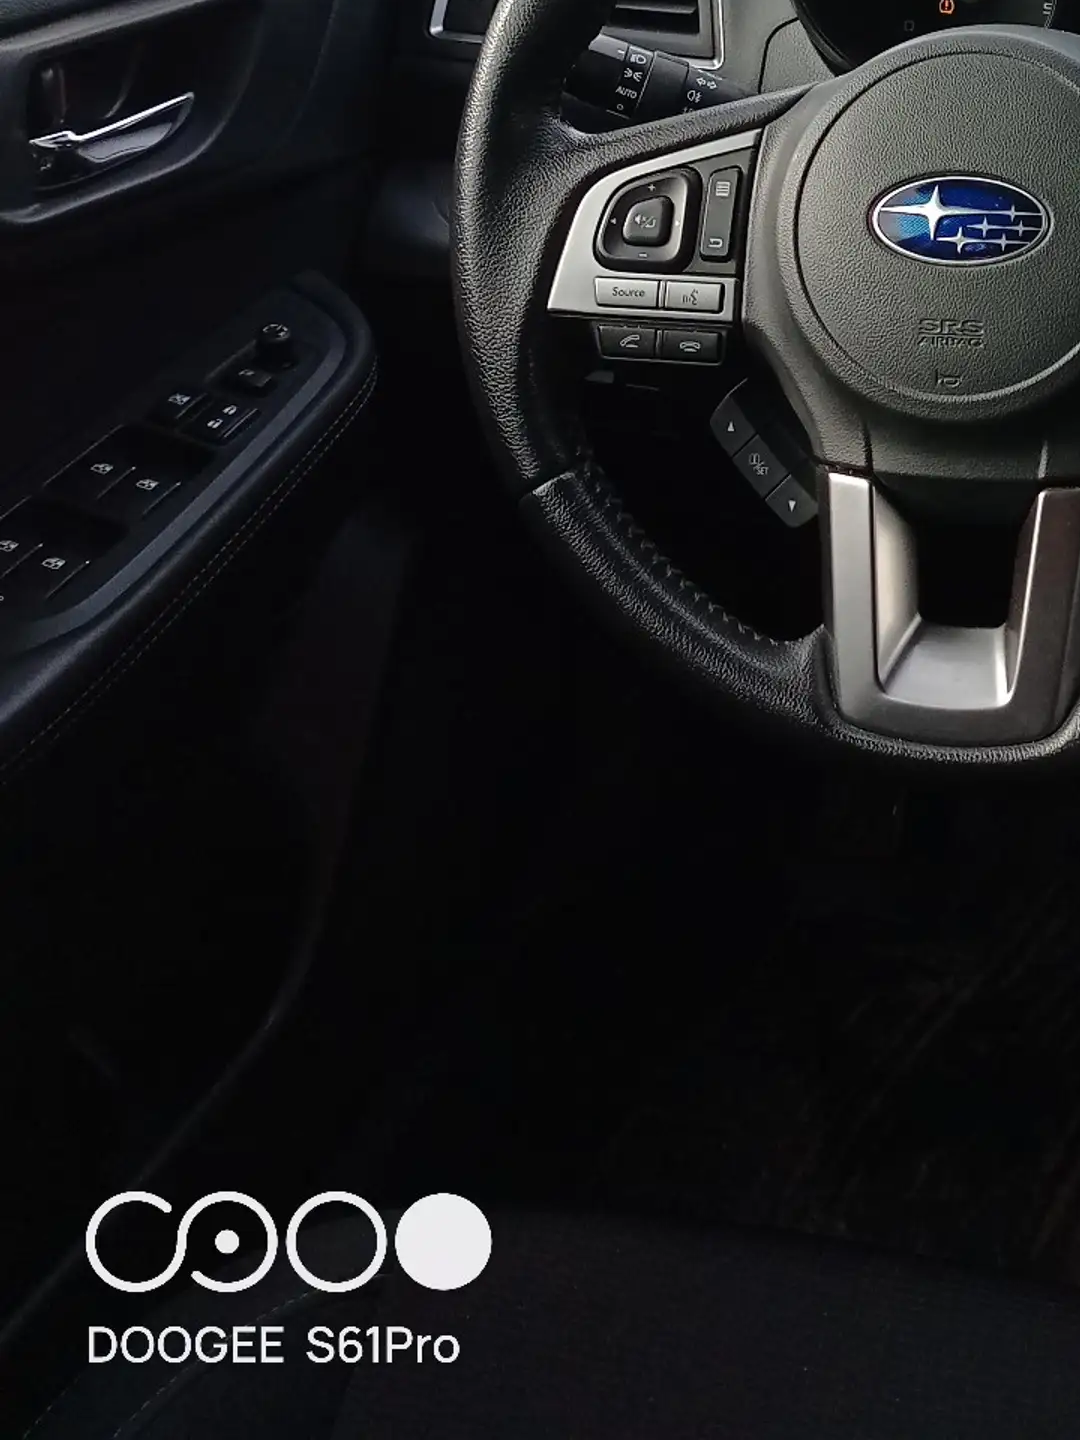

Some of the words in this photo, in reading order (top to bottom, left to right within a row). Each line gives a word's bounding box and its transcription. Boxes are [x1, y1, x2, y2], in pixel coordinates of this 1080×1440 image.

[615, 86, 638, 99] AUTO
[612, 287, 645, 297] Source
[918, 319, 984, 335] SRS
